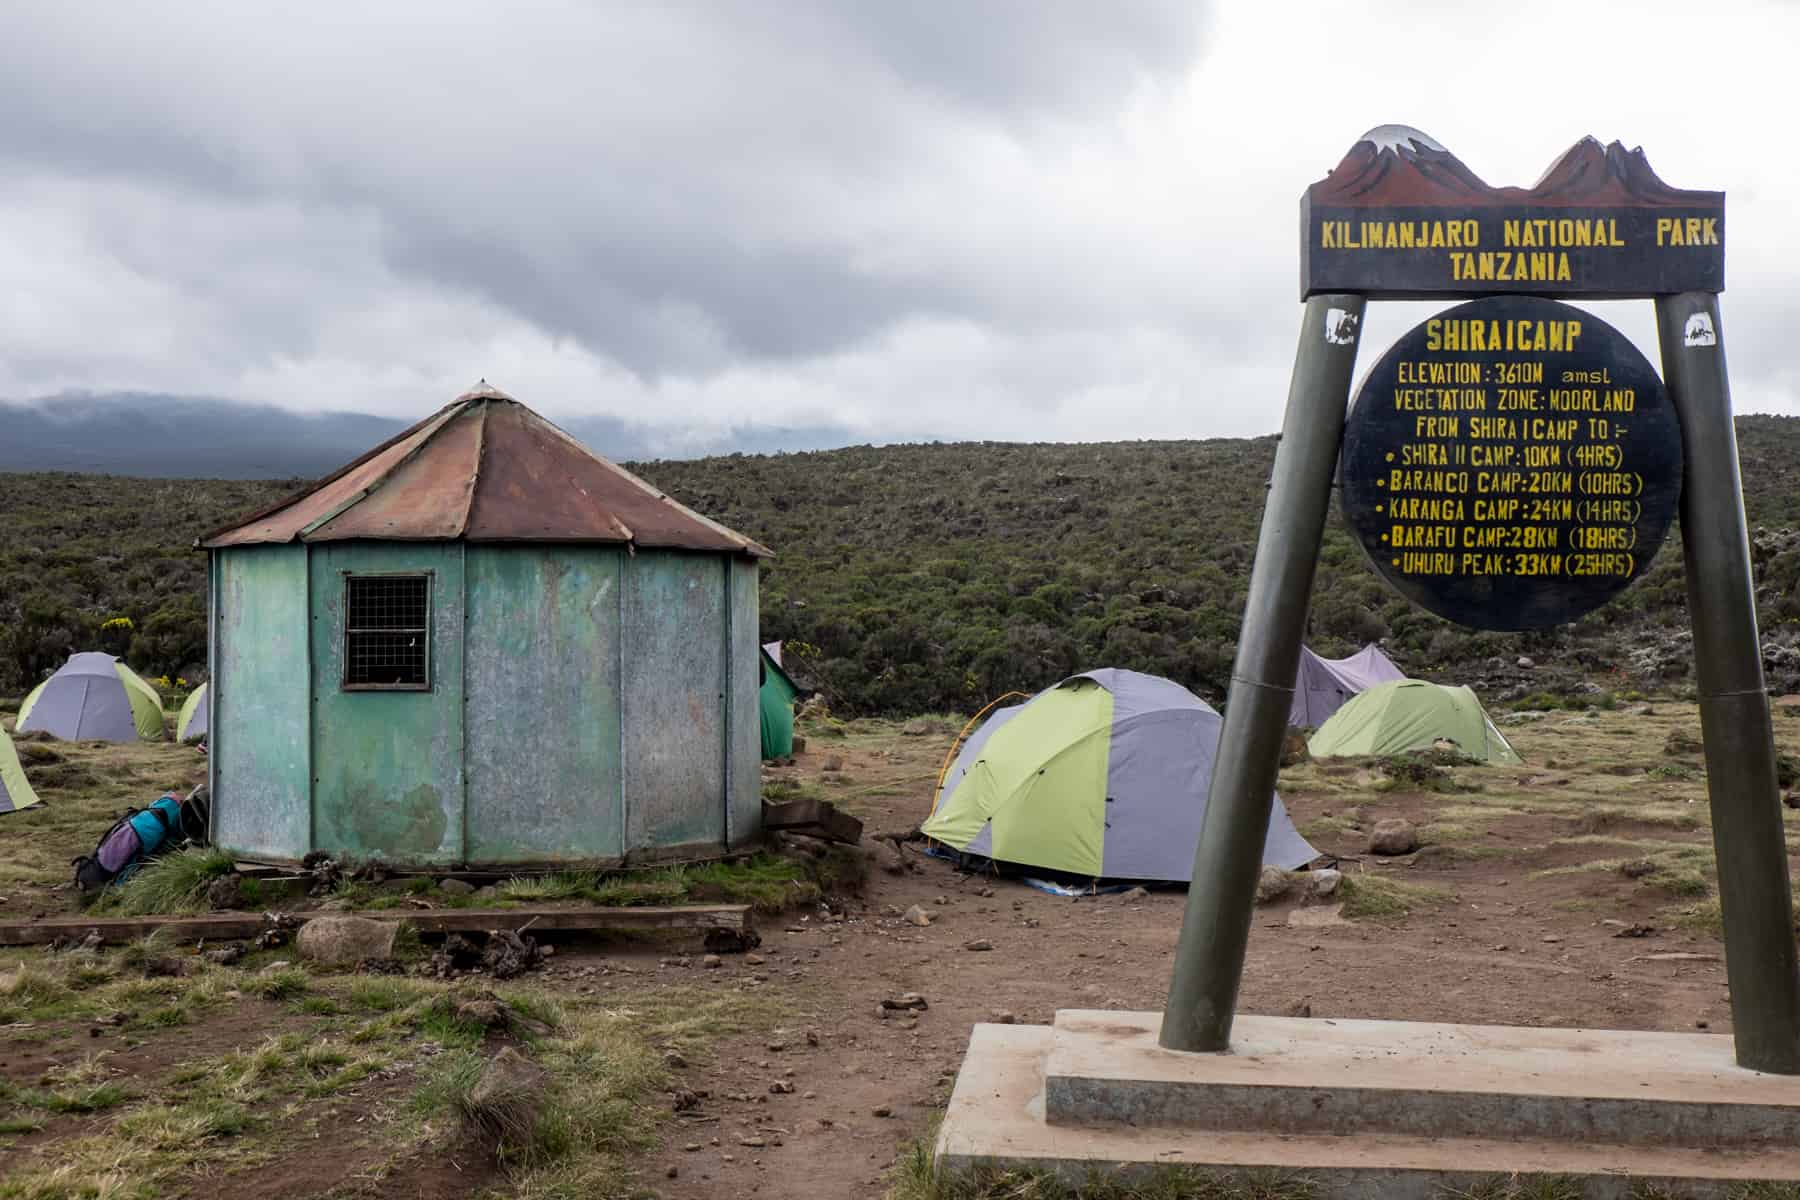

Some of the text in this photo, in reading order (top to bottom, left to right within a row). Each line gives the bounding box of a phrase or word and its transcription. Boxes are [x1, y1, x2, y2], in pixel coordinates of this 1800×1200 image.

[1321, 217, 1719, 249] KILIMANJARO NATIONAL PARK
[1450, 251, 1572, 281] TANZANIA
[1550, 389, 1635, 412] MOORLAND
[1416, 416, 1459, 438] FROM
[1470, 417, 1517, 439] SHIRA
[1532, 418, 1578, 441] CAMP
[1402, 444, 1448, 465] SHIRA
[1390, 469, 1468, 493] BARANCO
[1579, 471, 1643, 496] (10HRS)
[1390, 498, 1465, 520] KARANGA
[1391, 525, 1456, 548] BARAFU
[1403, 552, 1454, 574] UHURU
